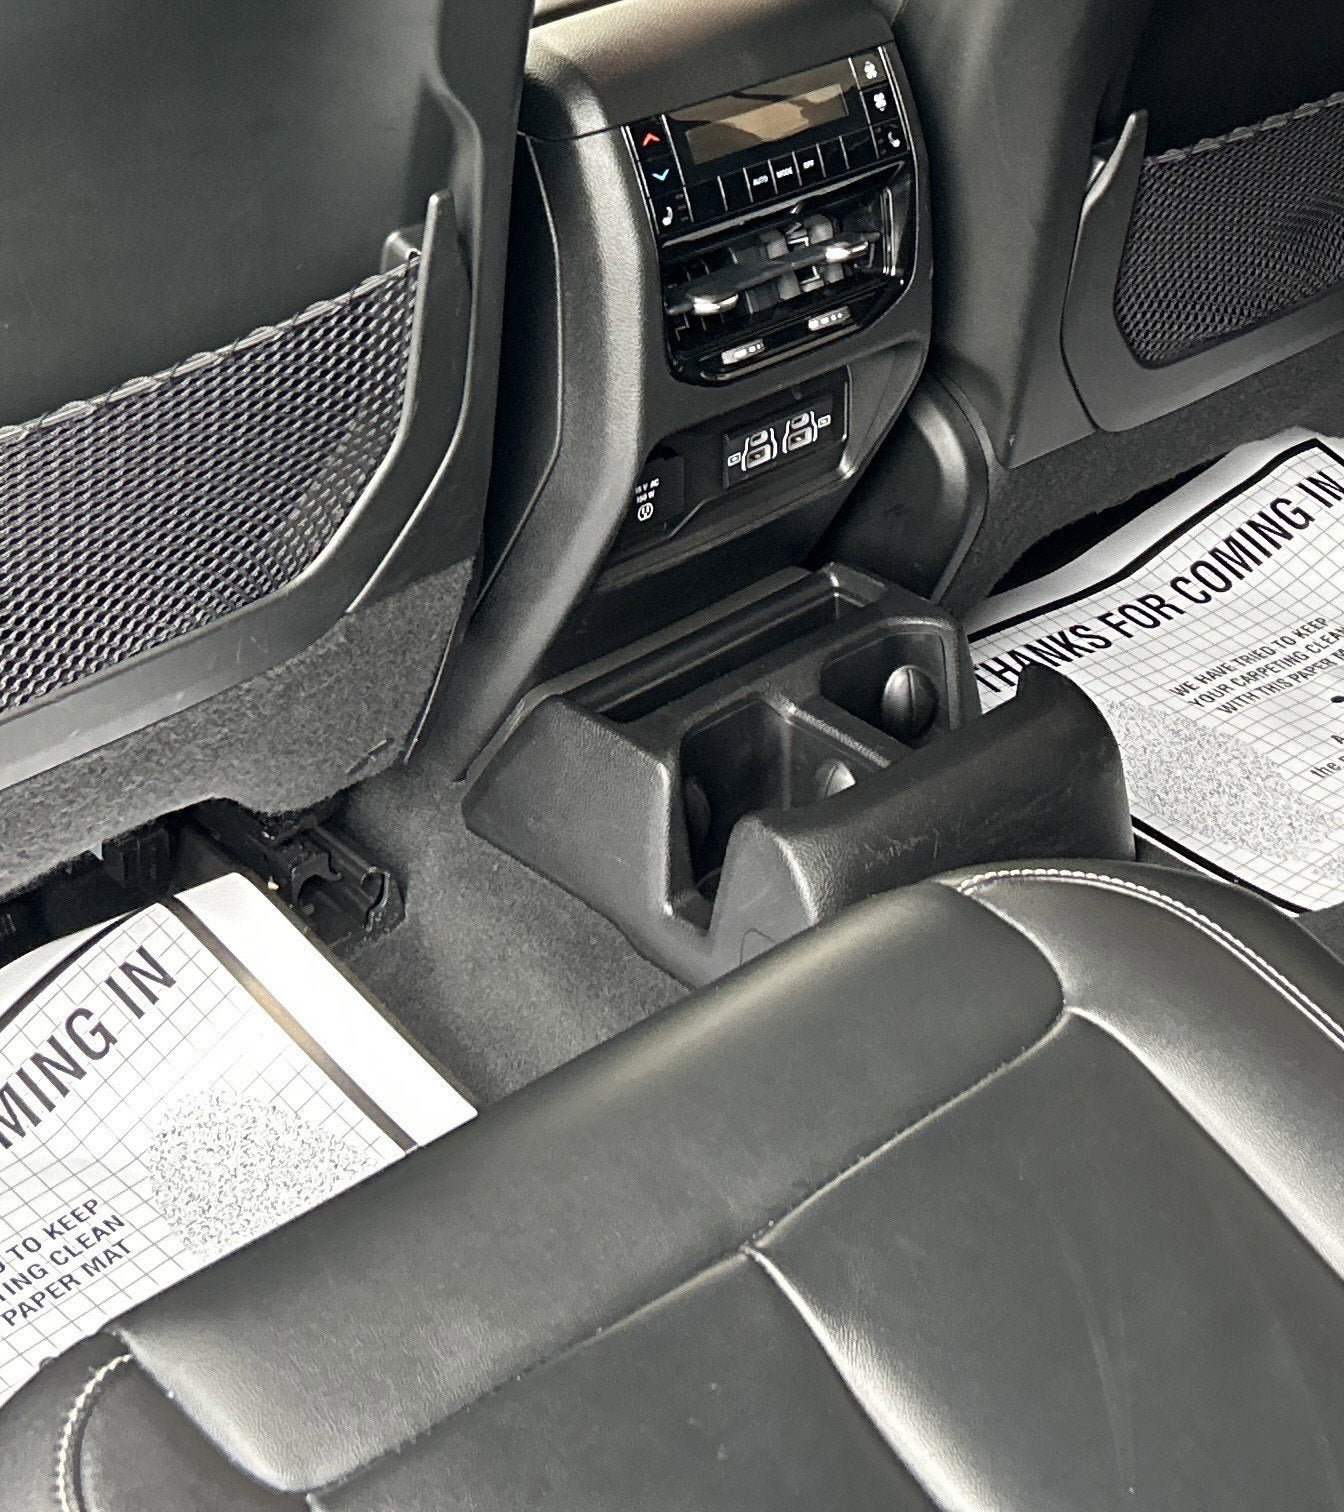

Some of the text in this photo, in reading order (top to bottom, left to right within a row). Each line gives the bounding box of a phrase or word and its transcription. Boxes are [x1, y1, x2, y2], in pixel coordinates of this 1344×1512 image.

[974, 624, 1113, 693] THANKS
[1097, 592, 1186, 639] FOR
[1170, 496, 1315, 604] COMING
[1169, 616, 1331, 697] WE HAVE TRIED TO KEEP
[1188, 683, 1235, 708] YOUR
[1230, 650, 1310, 687] CARPETING
[1216, 691, 1261, 715] WITH
[1255, 677, 1294, 696] THIS
[1288, 658, 1338, 684] PAPER
[1310, 762, 1342, 780] the
[104, 946, 177, 1019] IN
[5, 1236, 43, 1262] TO
[42, 1198, 100, 1239] KEEP
[49, 1214, 125, 1266] CLEAN
[1, 1273, 82, 1327] PAPER
[81, 1239, 133, 1277] MAT
